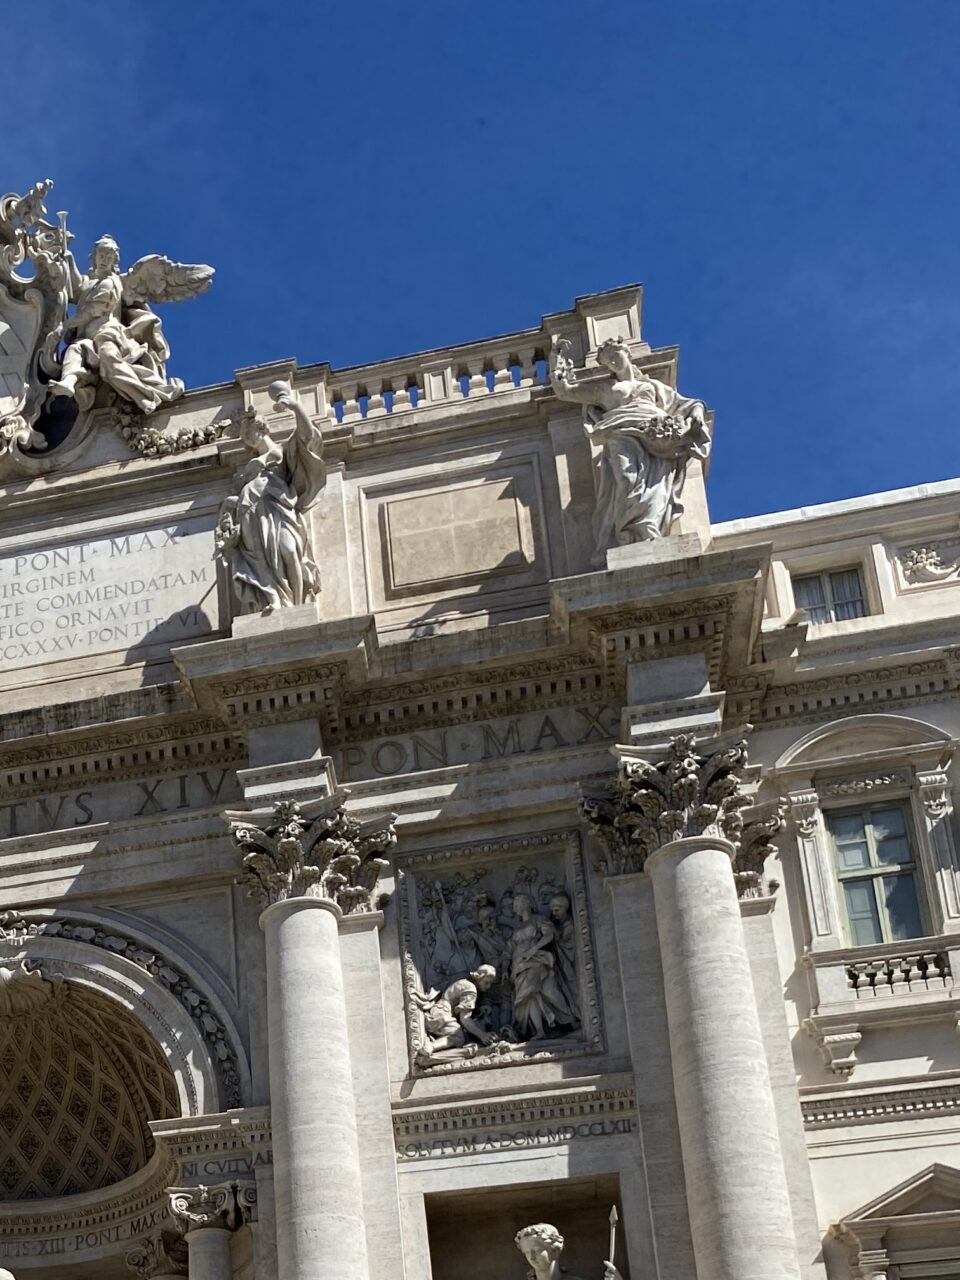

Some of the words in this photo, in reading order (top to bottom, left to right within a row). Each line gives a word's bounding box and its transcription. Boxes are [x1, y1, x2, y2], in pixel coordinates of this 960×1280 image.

[36, 567, 207, 612] COMMENDATAM
[55, 598, 155, 629] ORNAVIT
[397, 1138, 477, 1159] SOLVTVM
